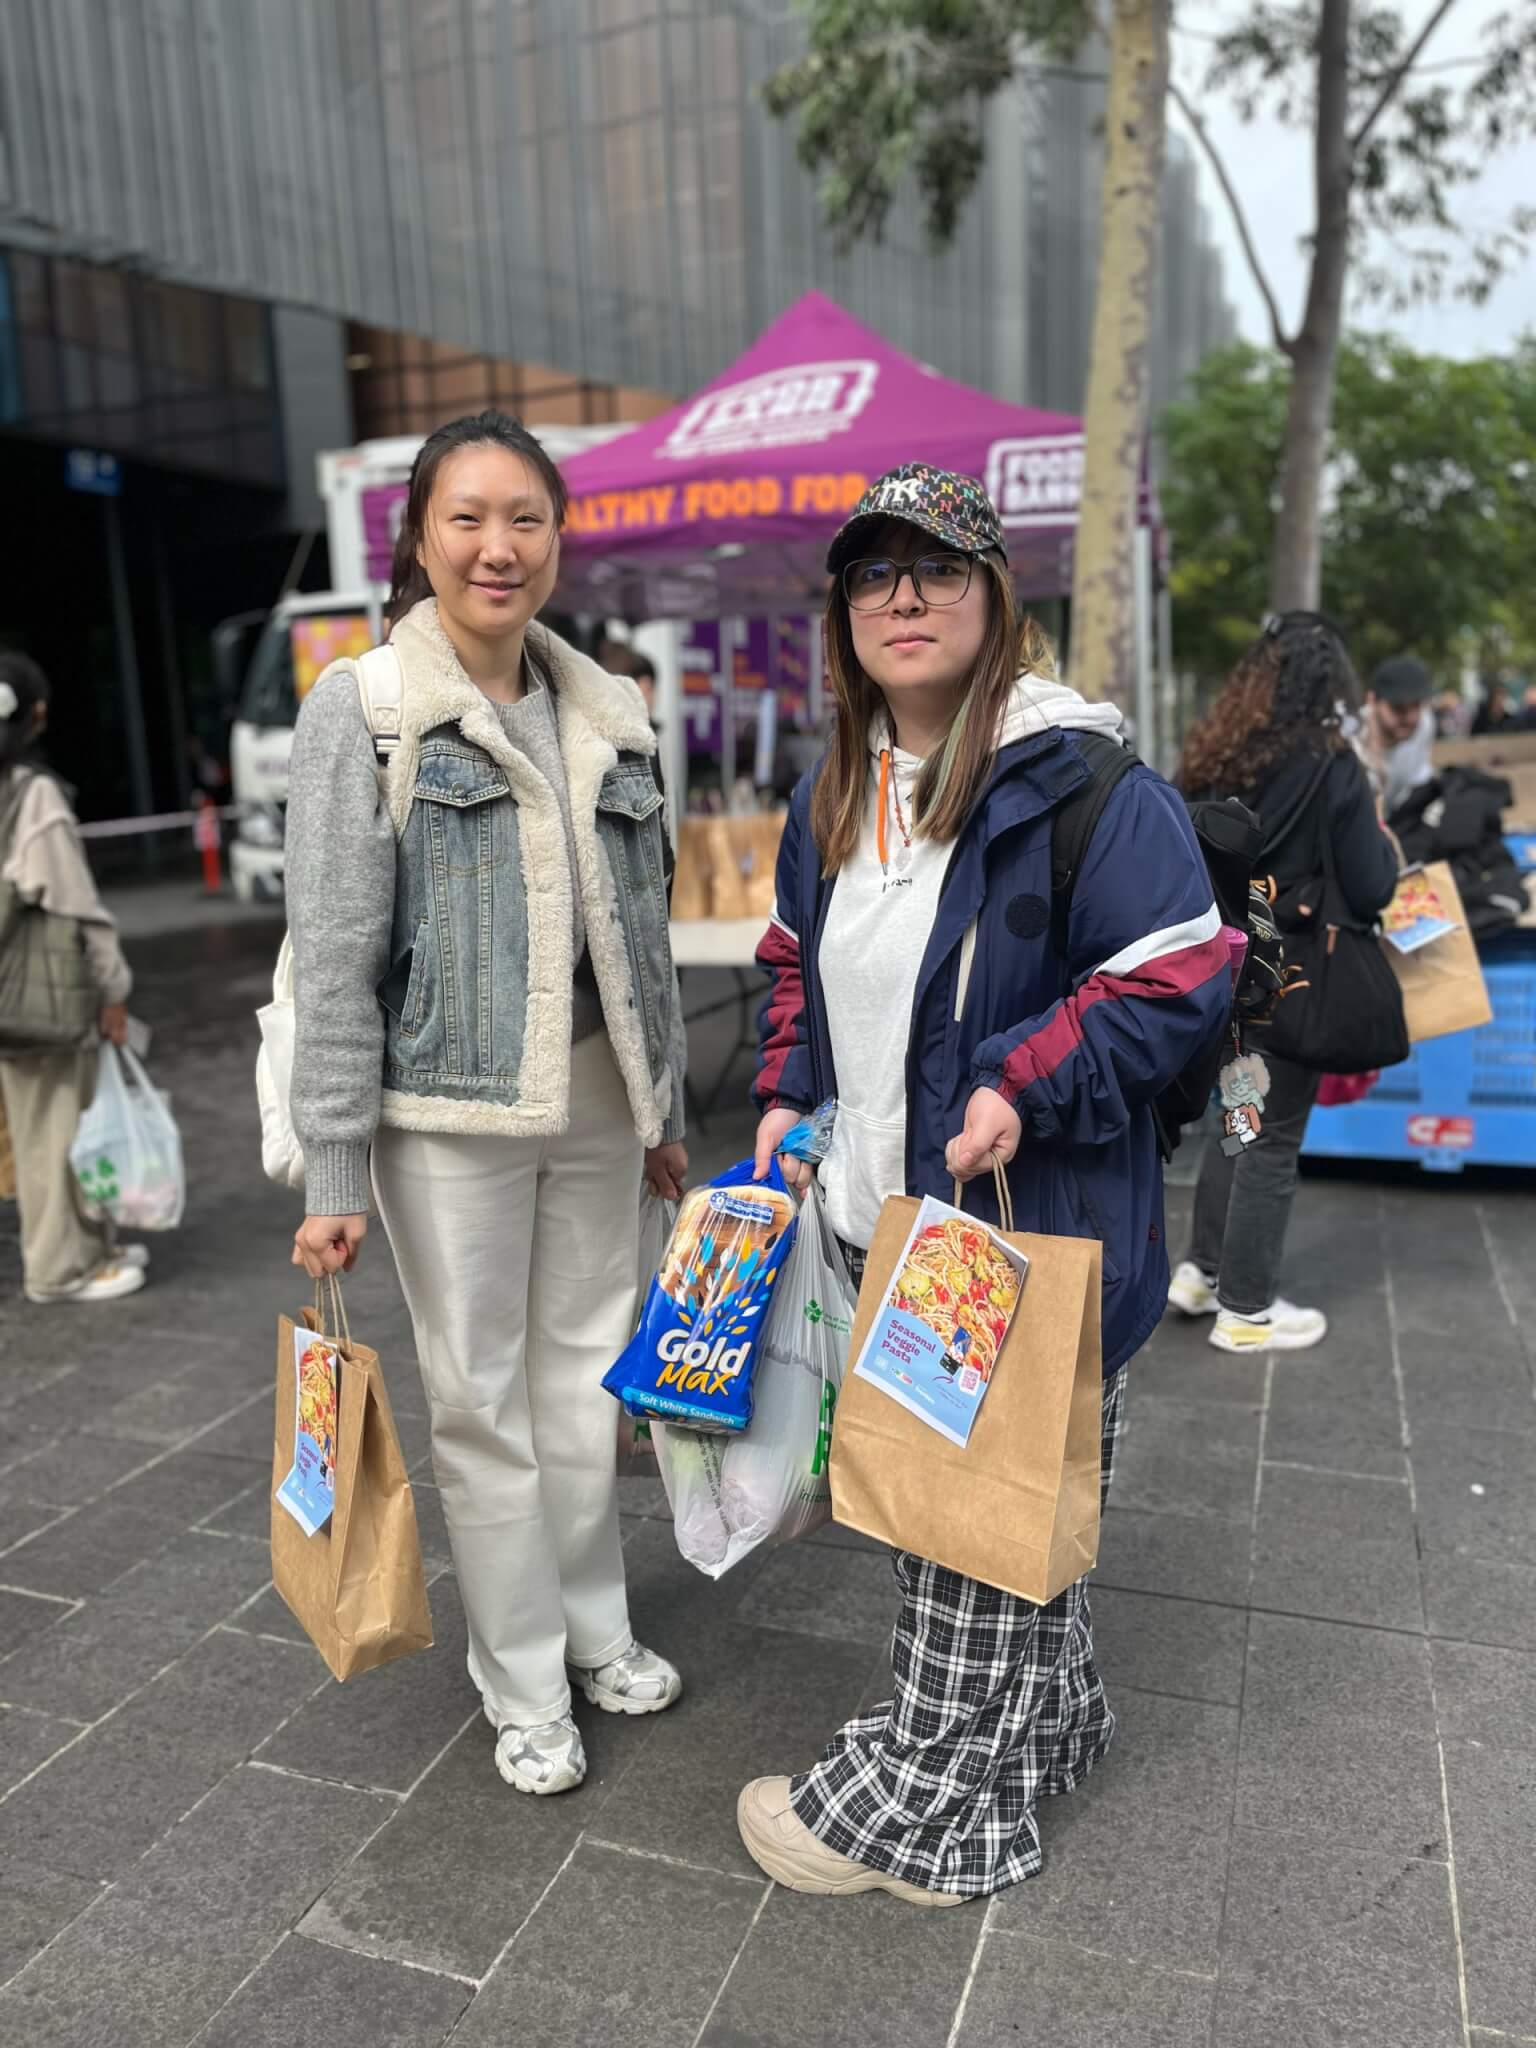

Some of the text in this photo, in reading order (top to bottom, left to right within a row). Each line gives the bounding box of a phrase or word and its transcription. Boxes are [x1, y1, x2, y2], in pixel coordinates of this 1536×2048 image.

[684, 475, 780, 521] FOOD
[657, 1328, 752, 1377] Gold
[881, 1339, 911, 1364] Pasta
[888, 1329, 920, 1356] Veggie
[890, 1320, 936, 1354] Seasonal
[655, 1363, 736, 1396] Max
[639, 1392, 735, 1425] Soft White Sandwich
